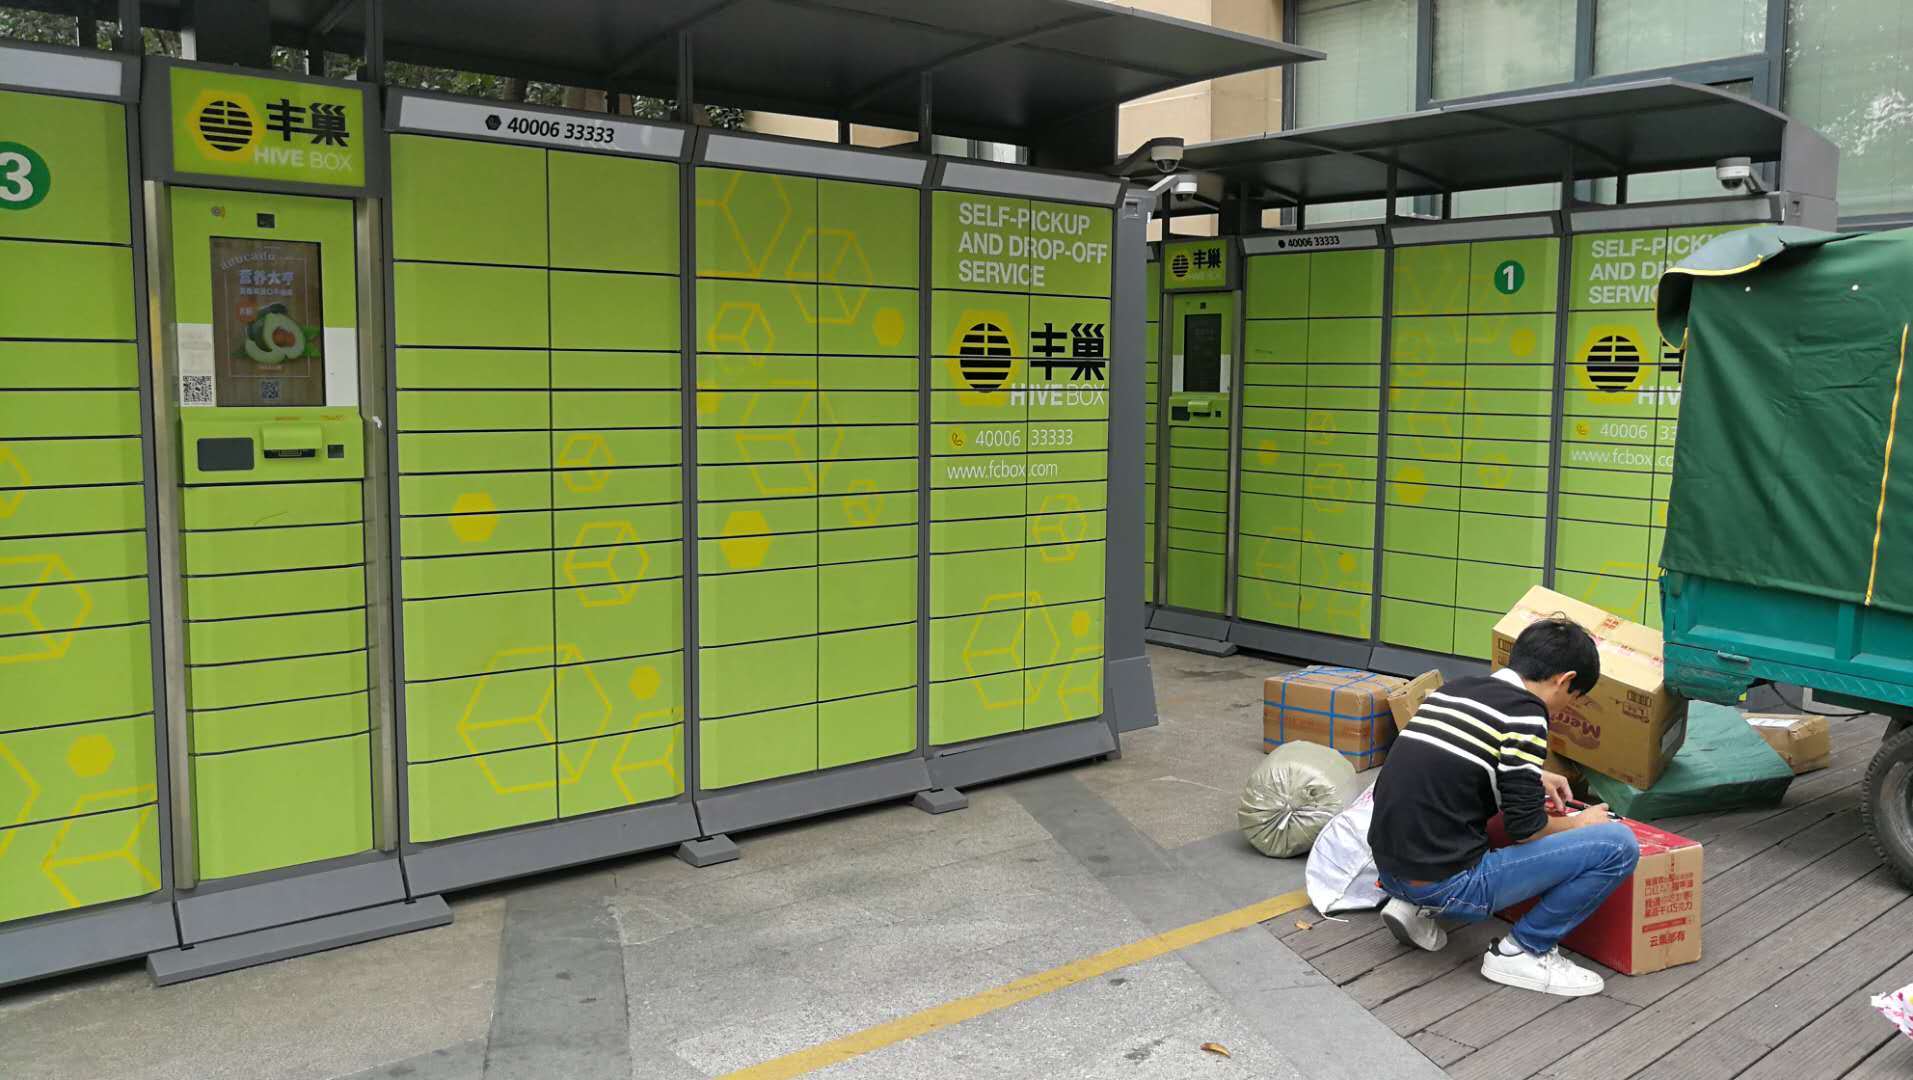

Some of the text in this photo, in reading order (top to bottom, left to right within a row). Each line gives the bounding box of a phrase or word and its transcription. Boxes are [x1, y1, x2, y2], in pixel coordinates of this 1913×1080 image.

[266, 98, 350, 147] 丰巢
[507, 116, 615, 144] 40006 33333
[256, 147, 353, 171] HIVE BOX
[0, 152, 33, 202] 3
[959, 202, 1090, 236] SELF-PICKUP
[959, 231, 1108, 264] AND DROP-OFF
[1288, 235, 1340, 248] 40006 33333
[1591, 234, 1713, 258] SELF-PICK
[959, 259, 1046, 287] SERVICE
[1502, 265, 1515, 290] 1
[1589, 262, 1636, 281] AND
[1030, 322, 1106, 381] 丰巢
[1010, 383, 1105, 406] HIVE BOX
[1637, 385, 1681, 406] HIV
[975, 429, 1073, 447] 40006 33333
[1600, 423, 1648, 439] 40006
[1570, 448, 1676, 467] www.fcbox.co
[947, 460, 1058, 480] www.fcbox.com
